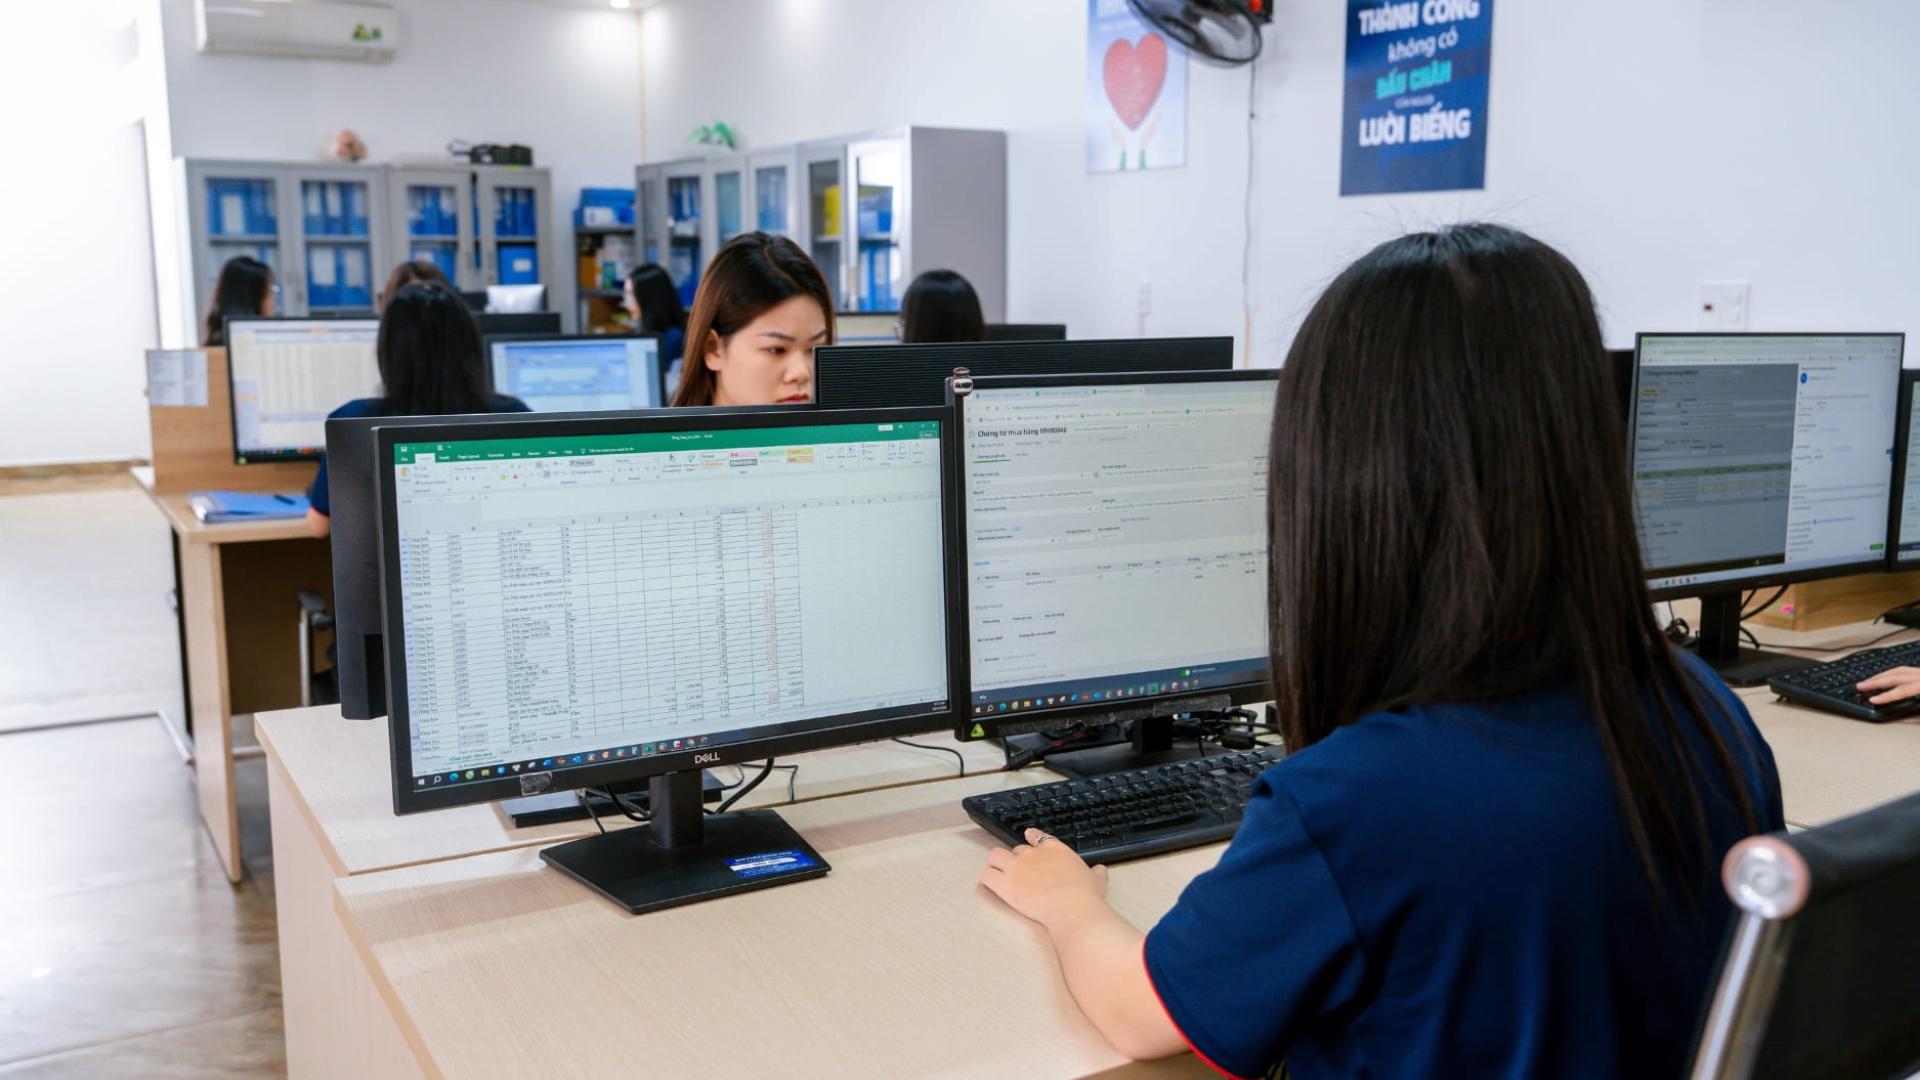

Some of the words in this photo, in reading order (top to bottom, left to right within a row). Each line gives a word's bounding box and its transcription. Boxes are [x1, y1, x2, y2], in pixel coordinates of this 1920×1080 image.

[1359, 0, 1418, 35] THÀNH
[1388, 37, 1435, 62] không
[1437, 26, 1459, 48] có
[1359, 111, 1406, 147] LƯỜI
[1408, 102, 1472, 143] BIẾNG
[695, 752, 720, 764] DELL
